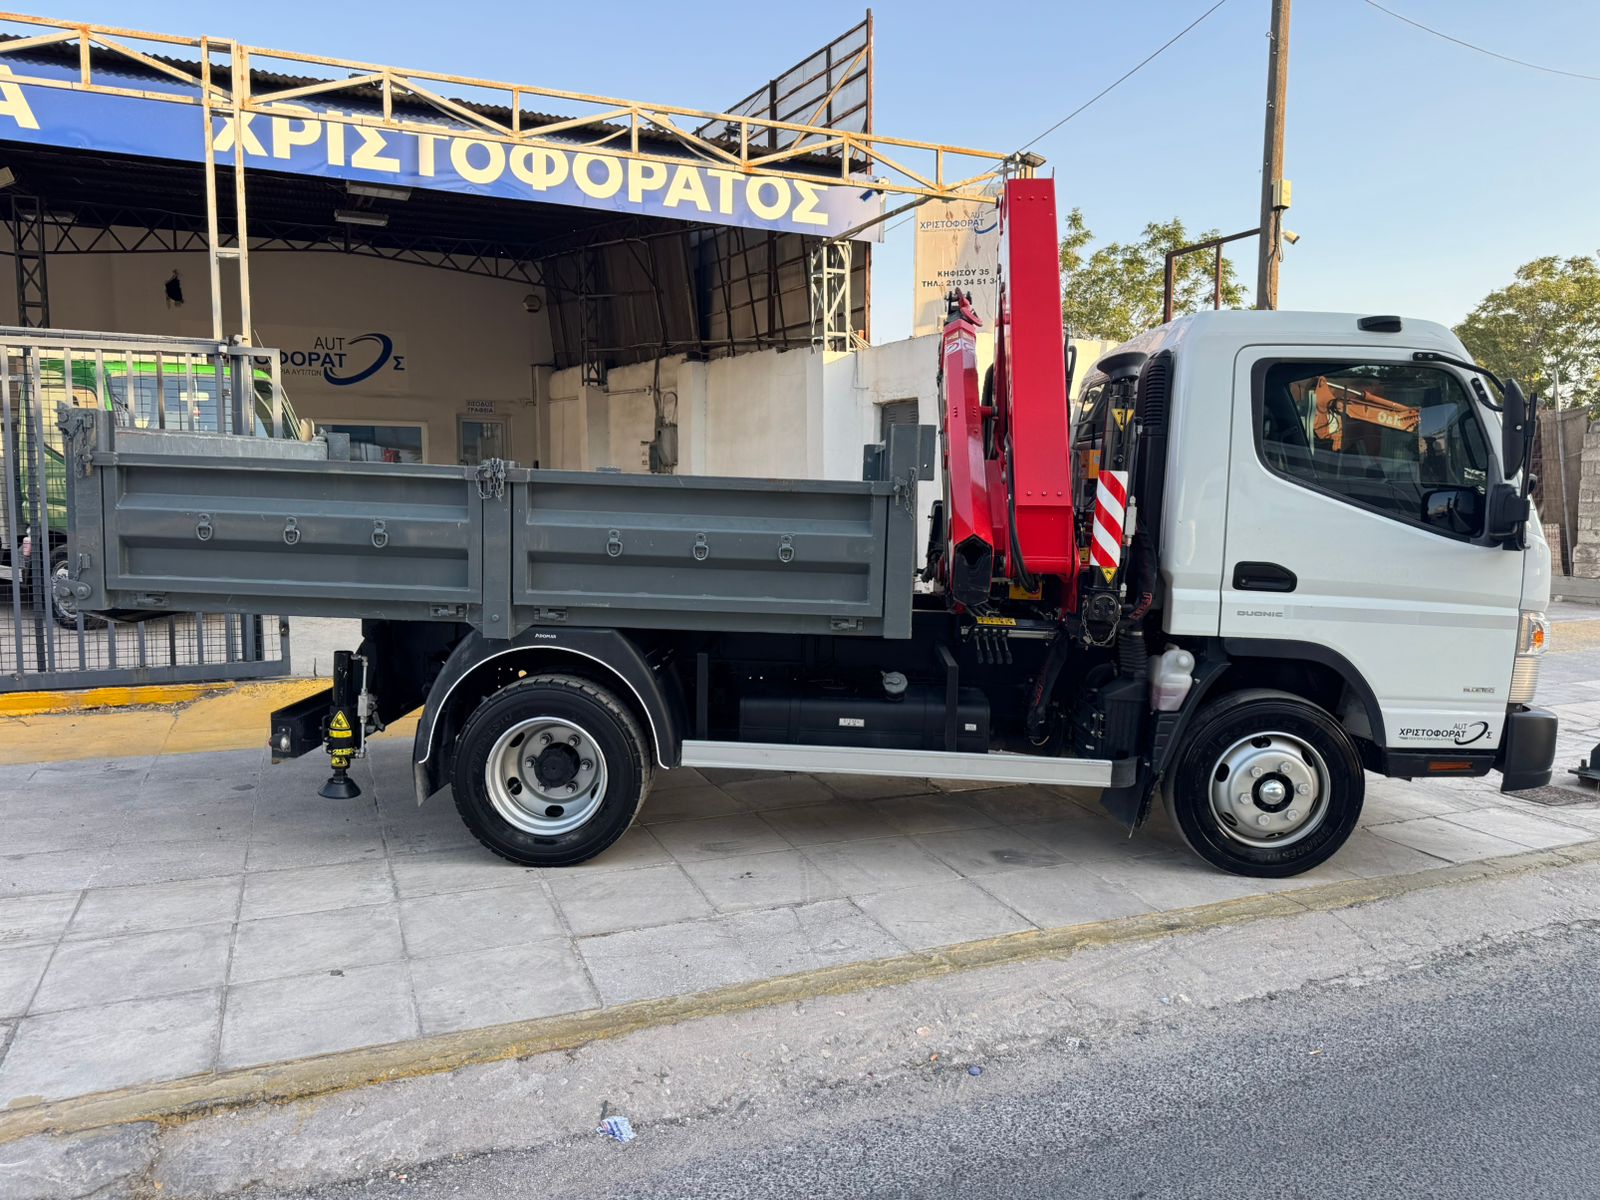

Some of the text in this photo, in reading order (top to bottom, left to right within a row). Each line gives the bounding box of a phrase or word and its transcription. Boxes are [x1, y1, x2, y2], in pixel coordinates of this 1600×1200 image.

[211, 101, 829, 226] ΧΡΙΣΤΟΦΟΡΑΤΟΣ
[937, 268, 990, 277] ΚΗΦΙΣΟΥ 35
[946, 279, 962, 287] 210
[964, 278, 974, 286] 34
